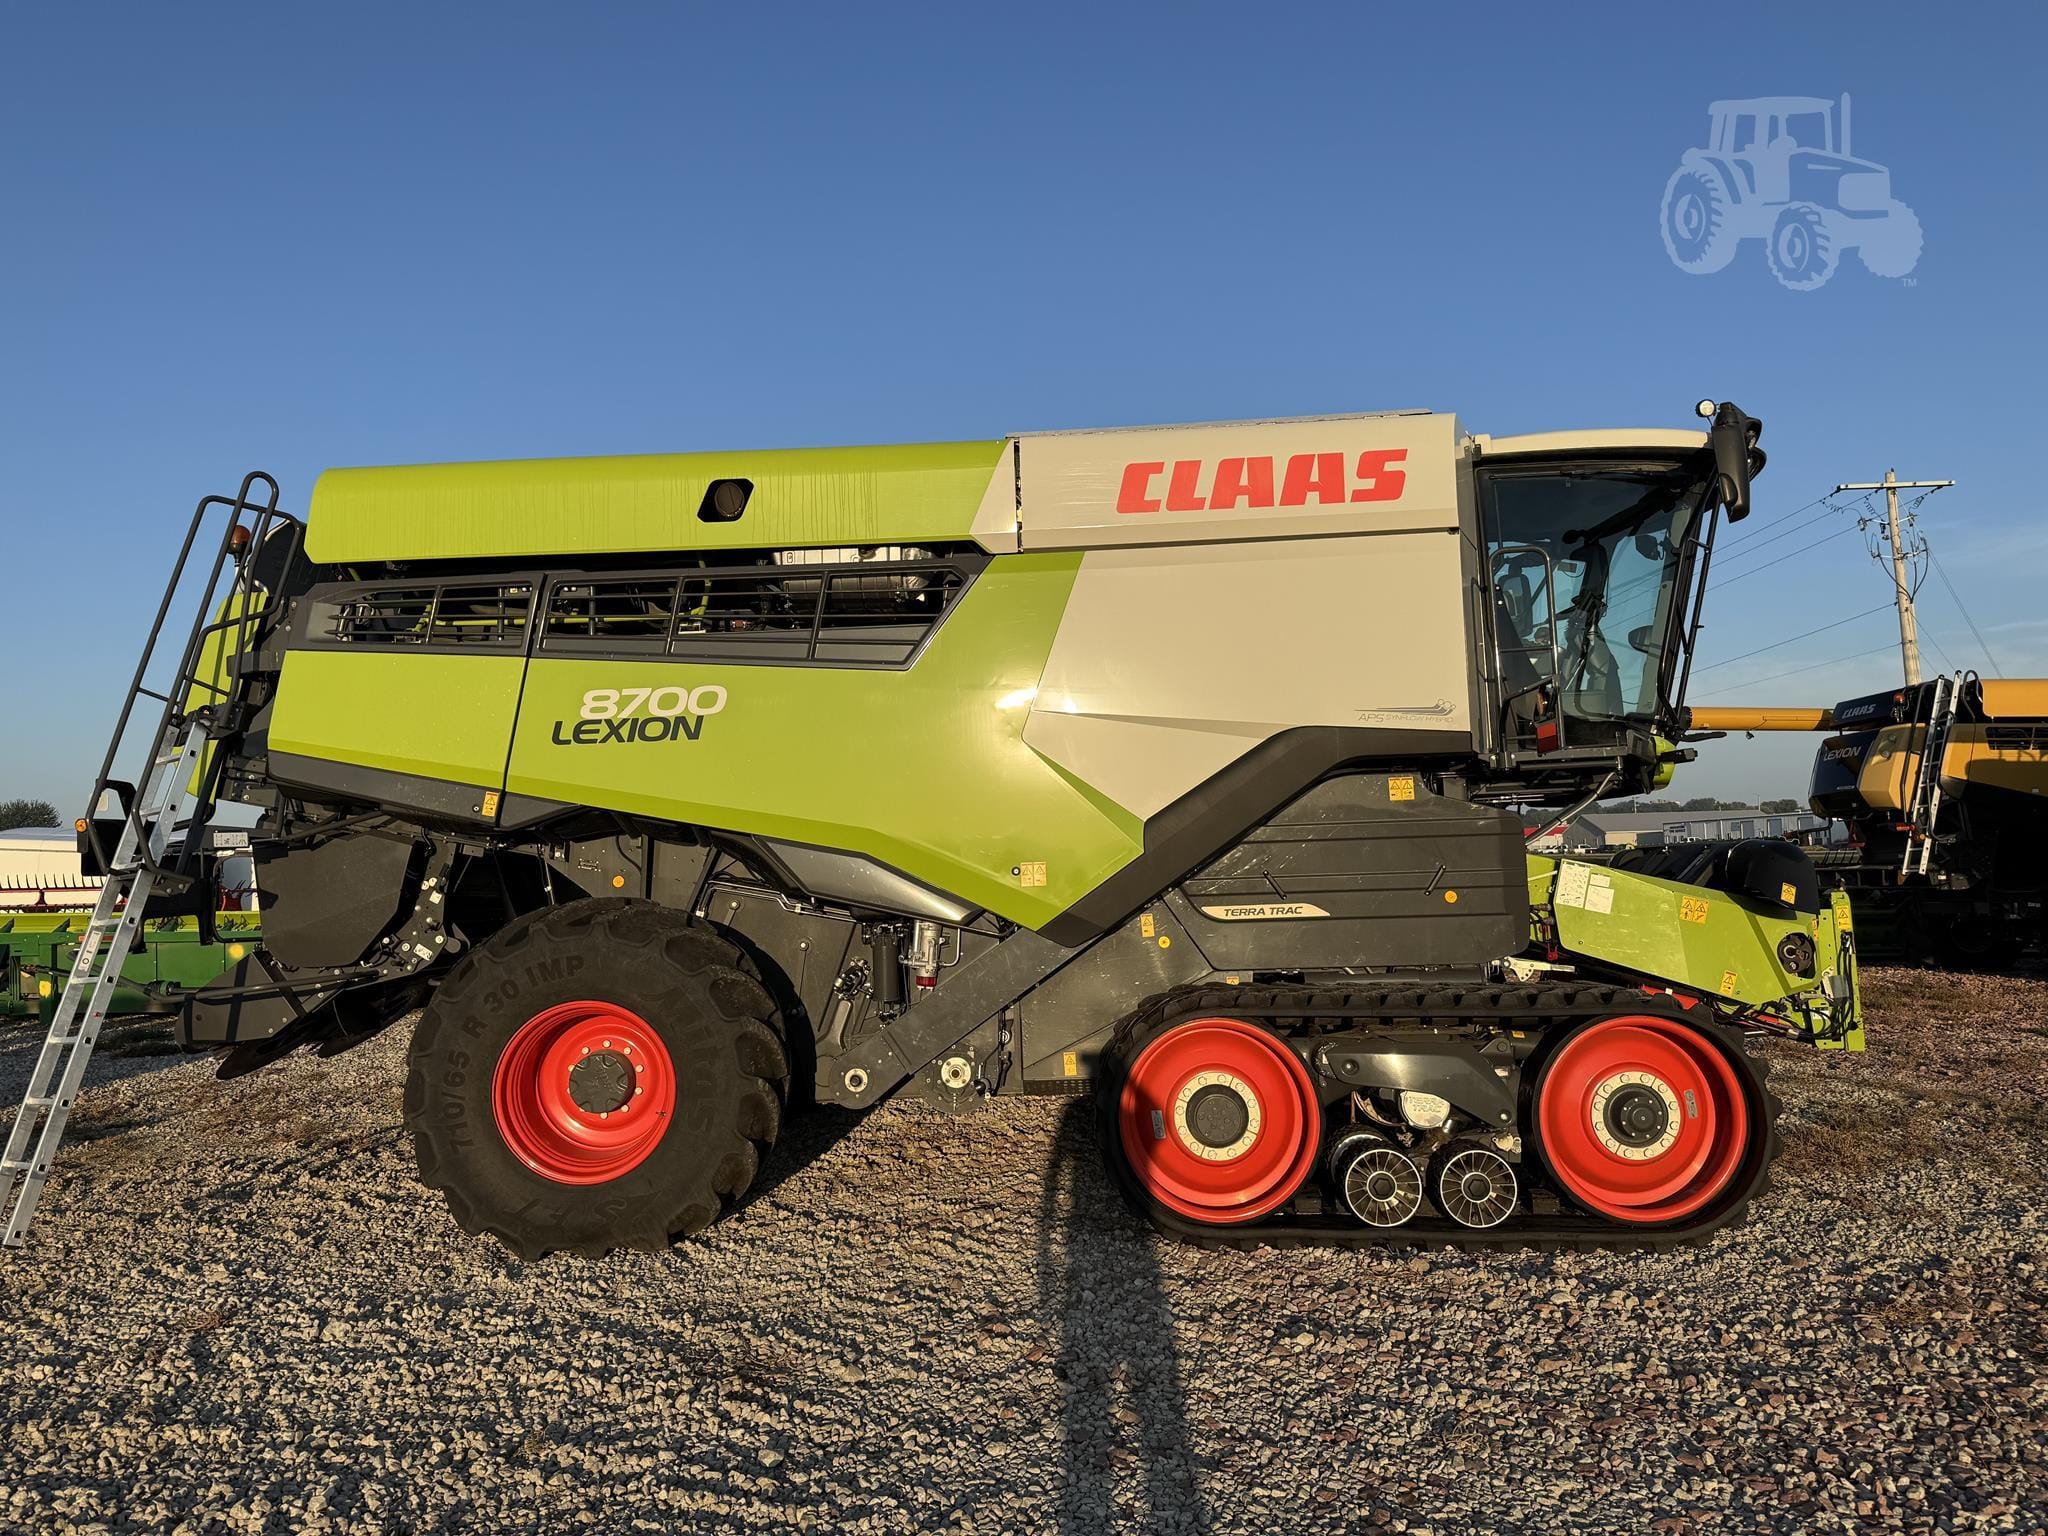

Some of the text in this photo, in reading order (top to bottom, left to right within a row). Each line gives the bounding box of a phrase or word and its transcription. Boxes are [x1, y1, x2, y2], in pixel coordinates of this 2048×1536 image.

[1116, 448, 1408, 514] CLAAS
[579, 685, 728, 719] 8700
[1842, 703, 1877, 719] CLAAS
[1358, 713, 1385, 723] APS
[551, 715, 705, 746] LEXION
[1824, 746, 1862, 761] LEXION
[1223, 906, 1304, 917] TERRA TRAC
[442, 954, 586, 1156] 710/65 R 30 IMP
